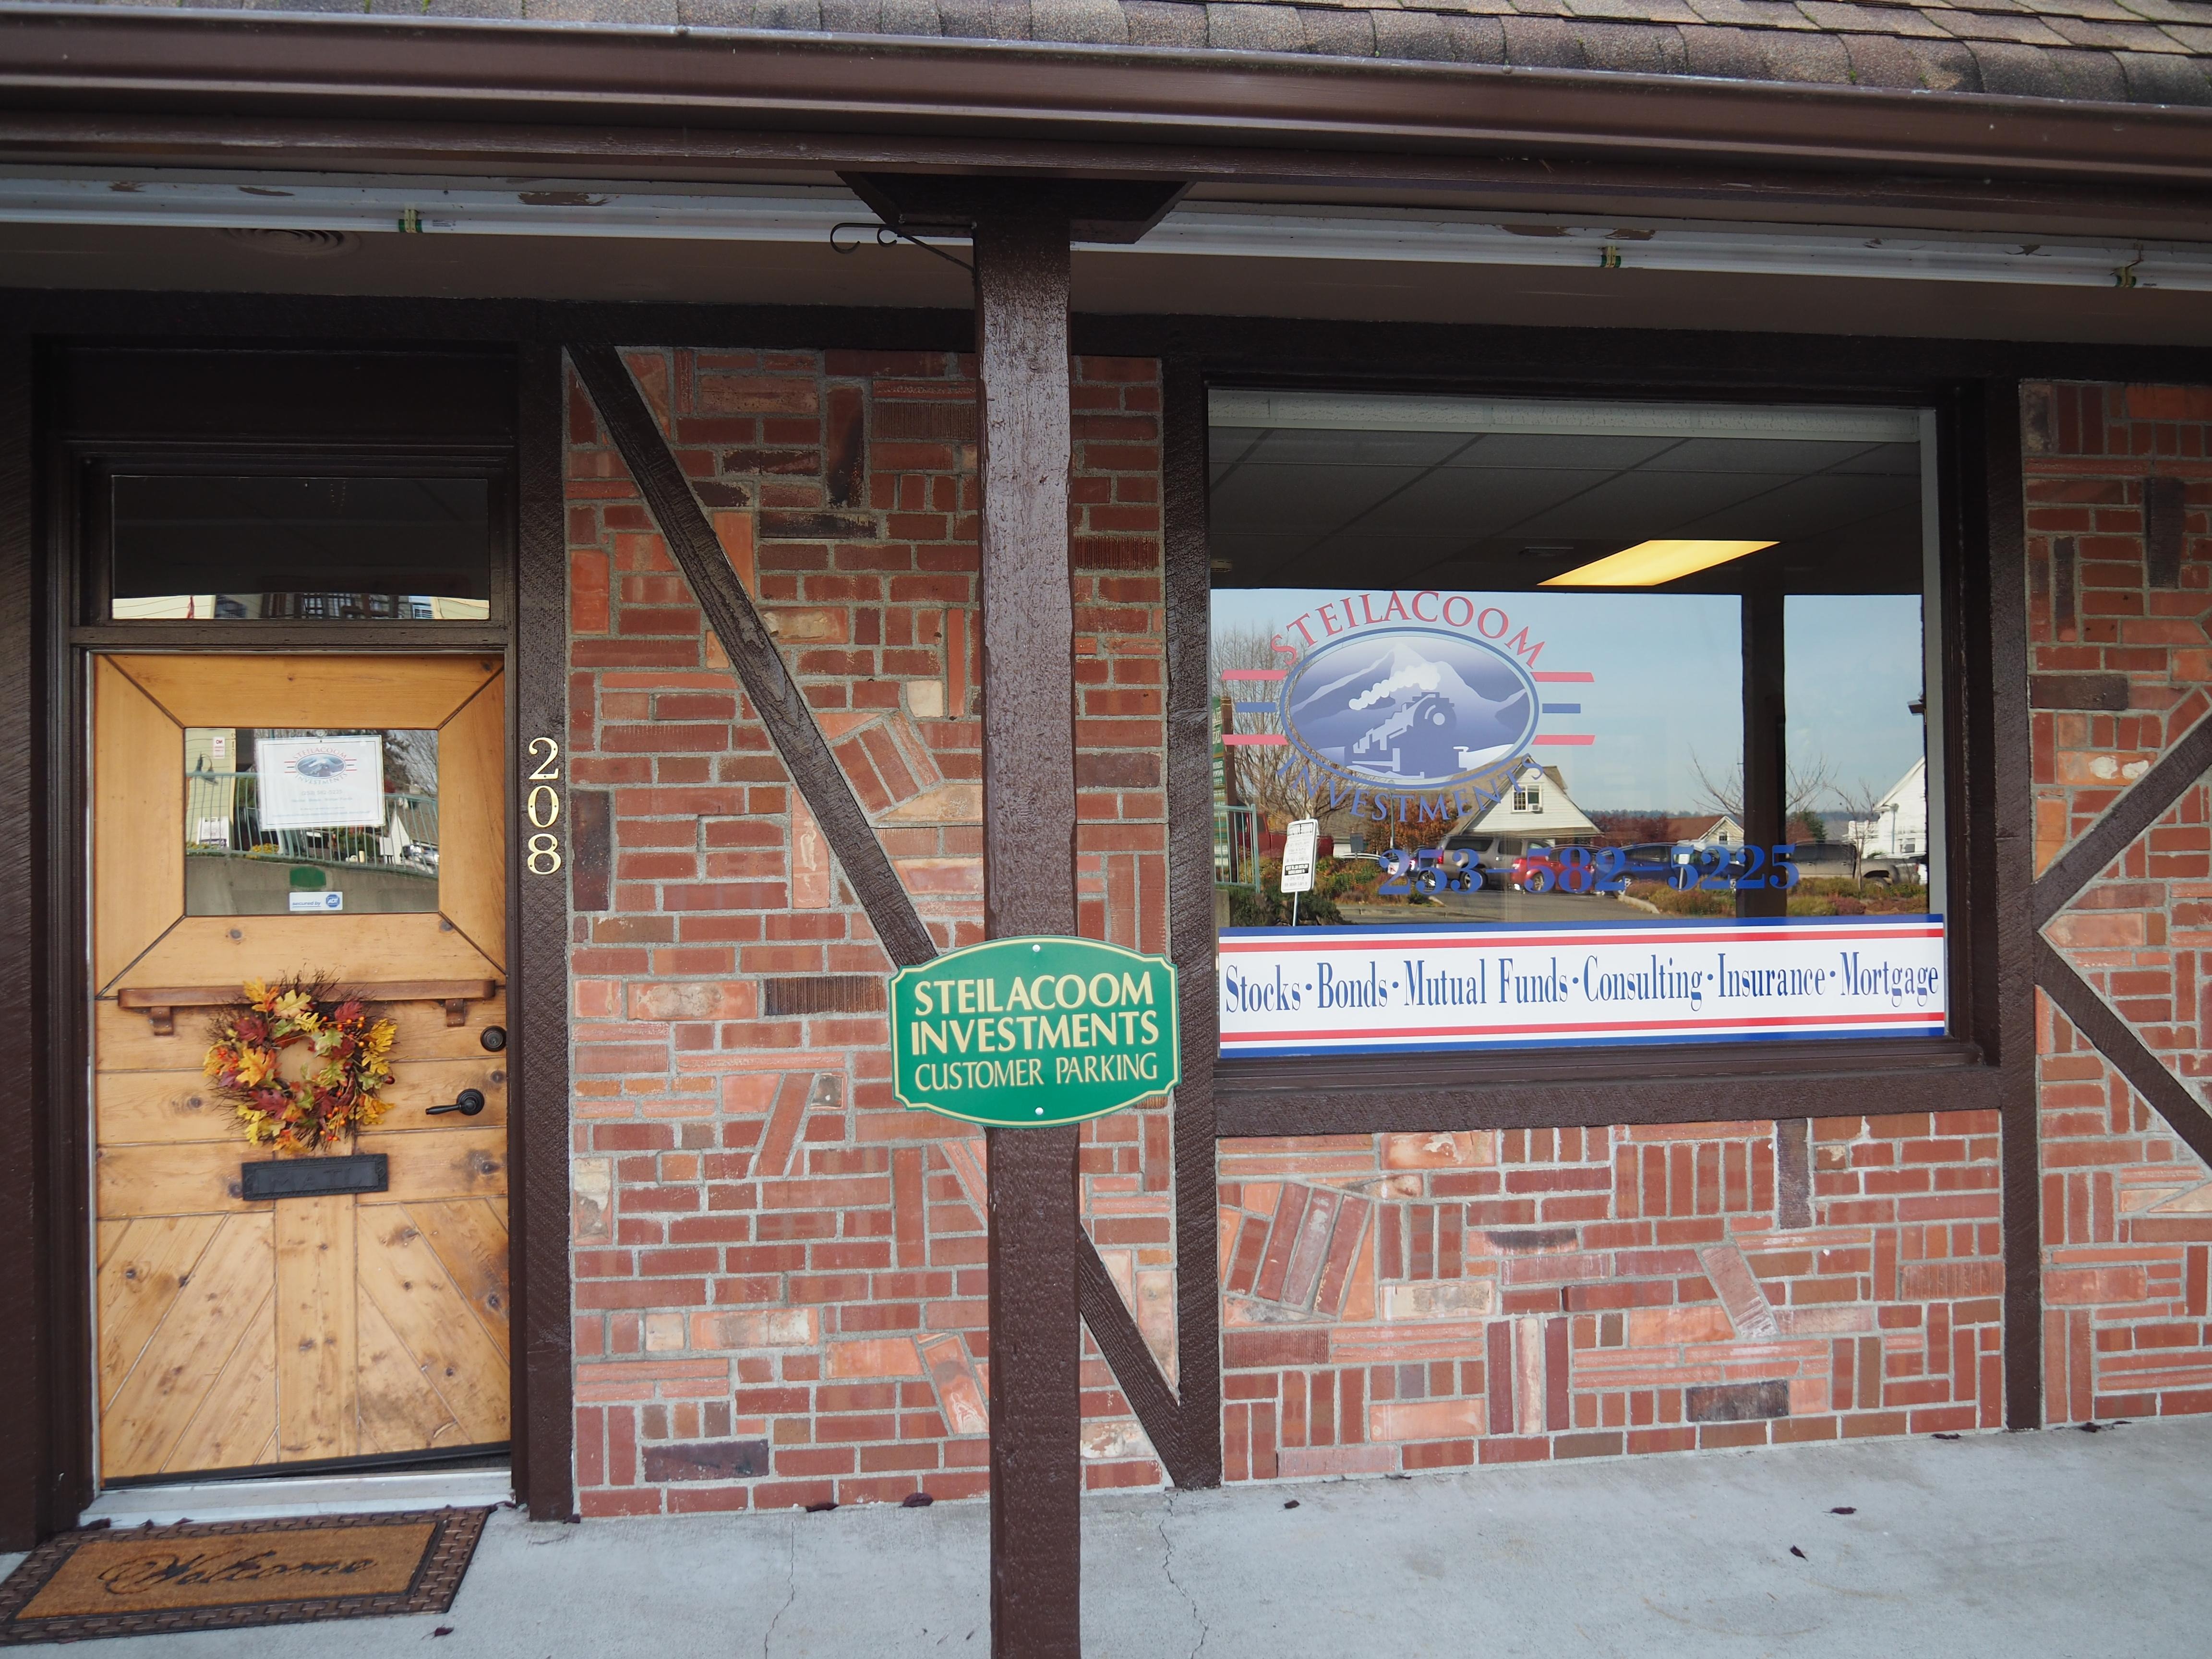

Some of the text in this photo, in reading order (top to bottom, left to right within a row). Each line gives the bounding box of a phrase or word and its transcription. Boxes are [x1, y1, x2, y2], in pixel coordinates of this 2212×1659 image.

[1270, 590, 1545, 669] STEILACOOM
[293, 747, 347, 759] STEILACOOM
[294, 772, 348, 785] INVESTMENTS
[1277, 753, 1544, 822] INVESTMENTS
[527, 737, 561, 875] 208
[1378, 843, 1799, 895] 253-582-5225
[914, 971, 1154, 1016] STEILACOOM
[1226, 951, 1939, 1012] Stocks Bonds Mutual Funds Consulting Insurance Mortgage
[912, 1010, 1159, 1055] INVESTMENTS
[915, 1052, 1157, 1091] CUSTOMER PARKING
[98, 1548, 378, 1595] Welcome
